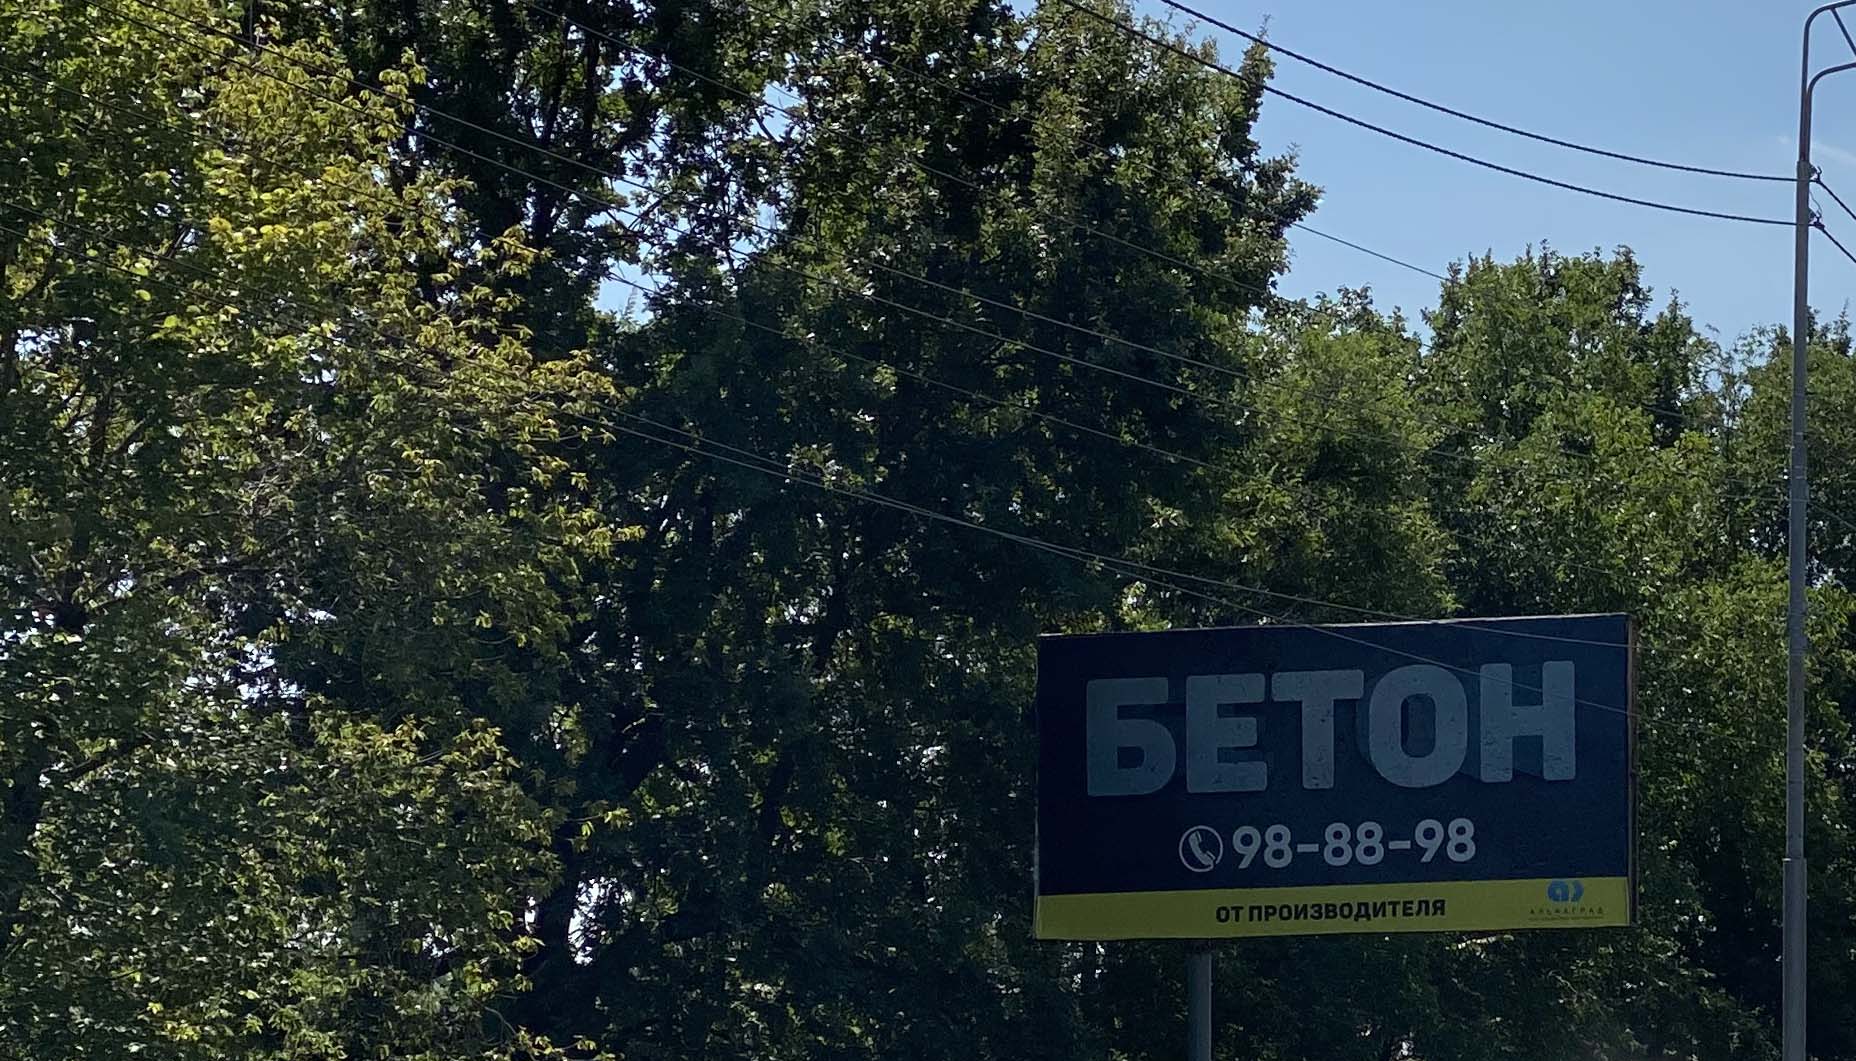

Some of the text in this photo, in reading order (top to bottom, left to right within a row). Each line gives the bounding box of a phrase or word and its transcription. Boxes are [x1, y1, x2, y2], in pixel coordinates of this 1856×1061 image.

[1086, 660, 1576, 797] БЕТОН
[1232, 817, 1476, 869] 98-88-98
[1216, 899, 1446, 923] ОТ ПРОИЗВОДИТЕЛЯ
